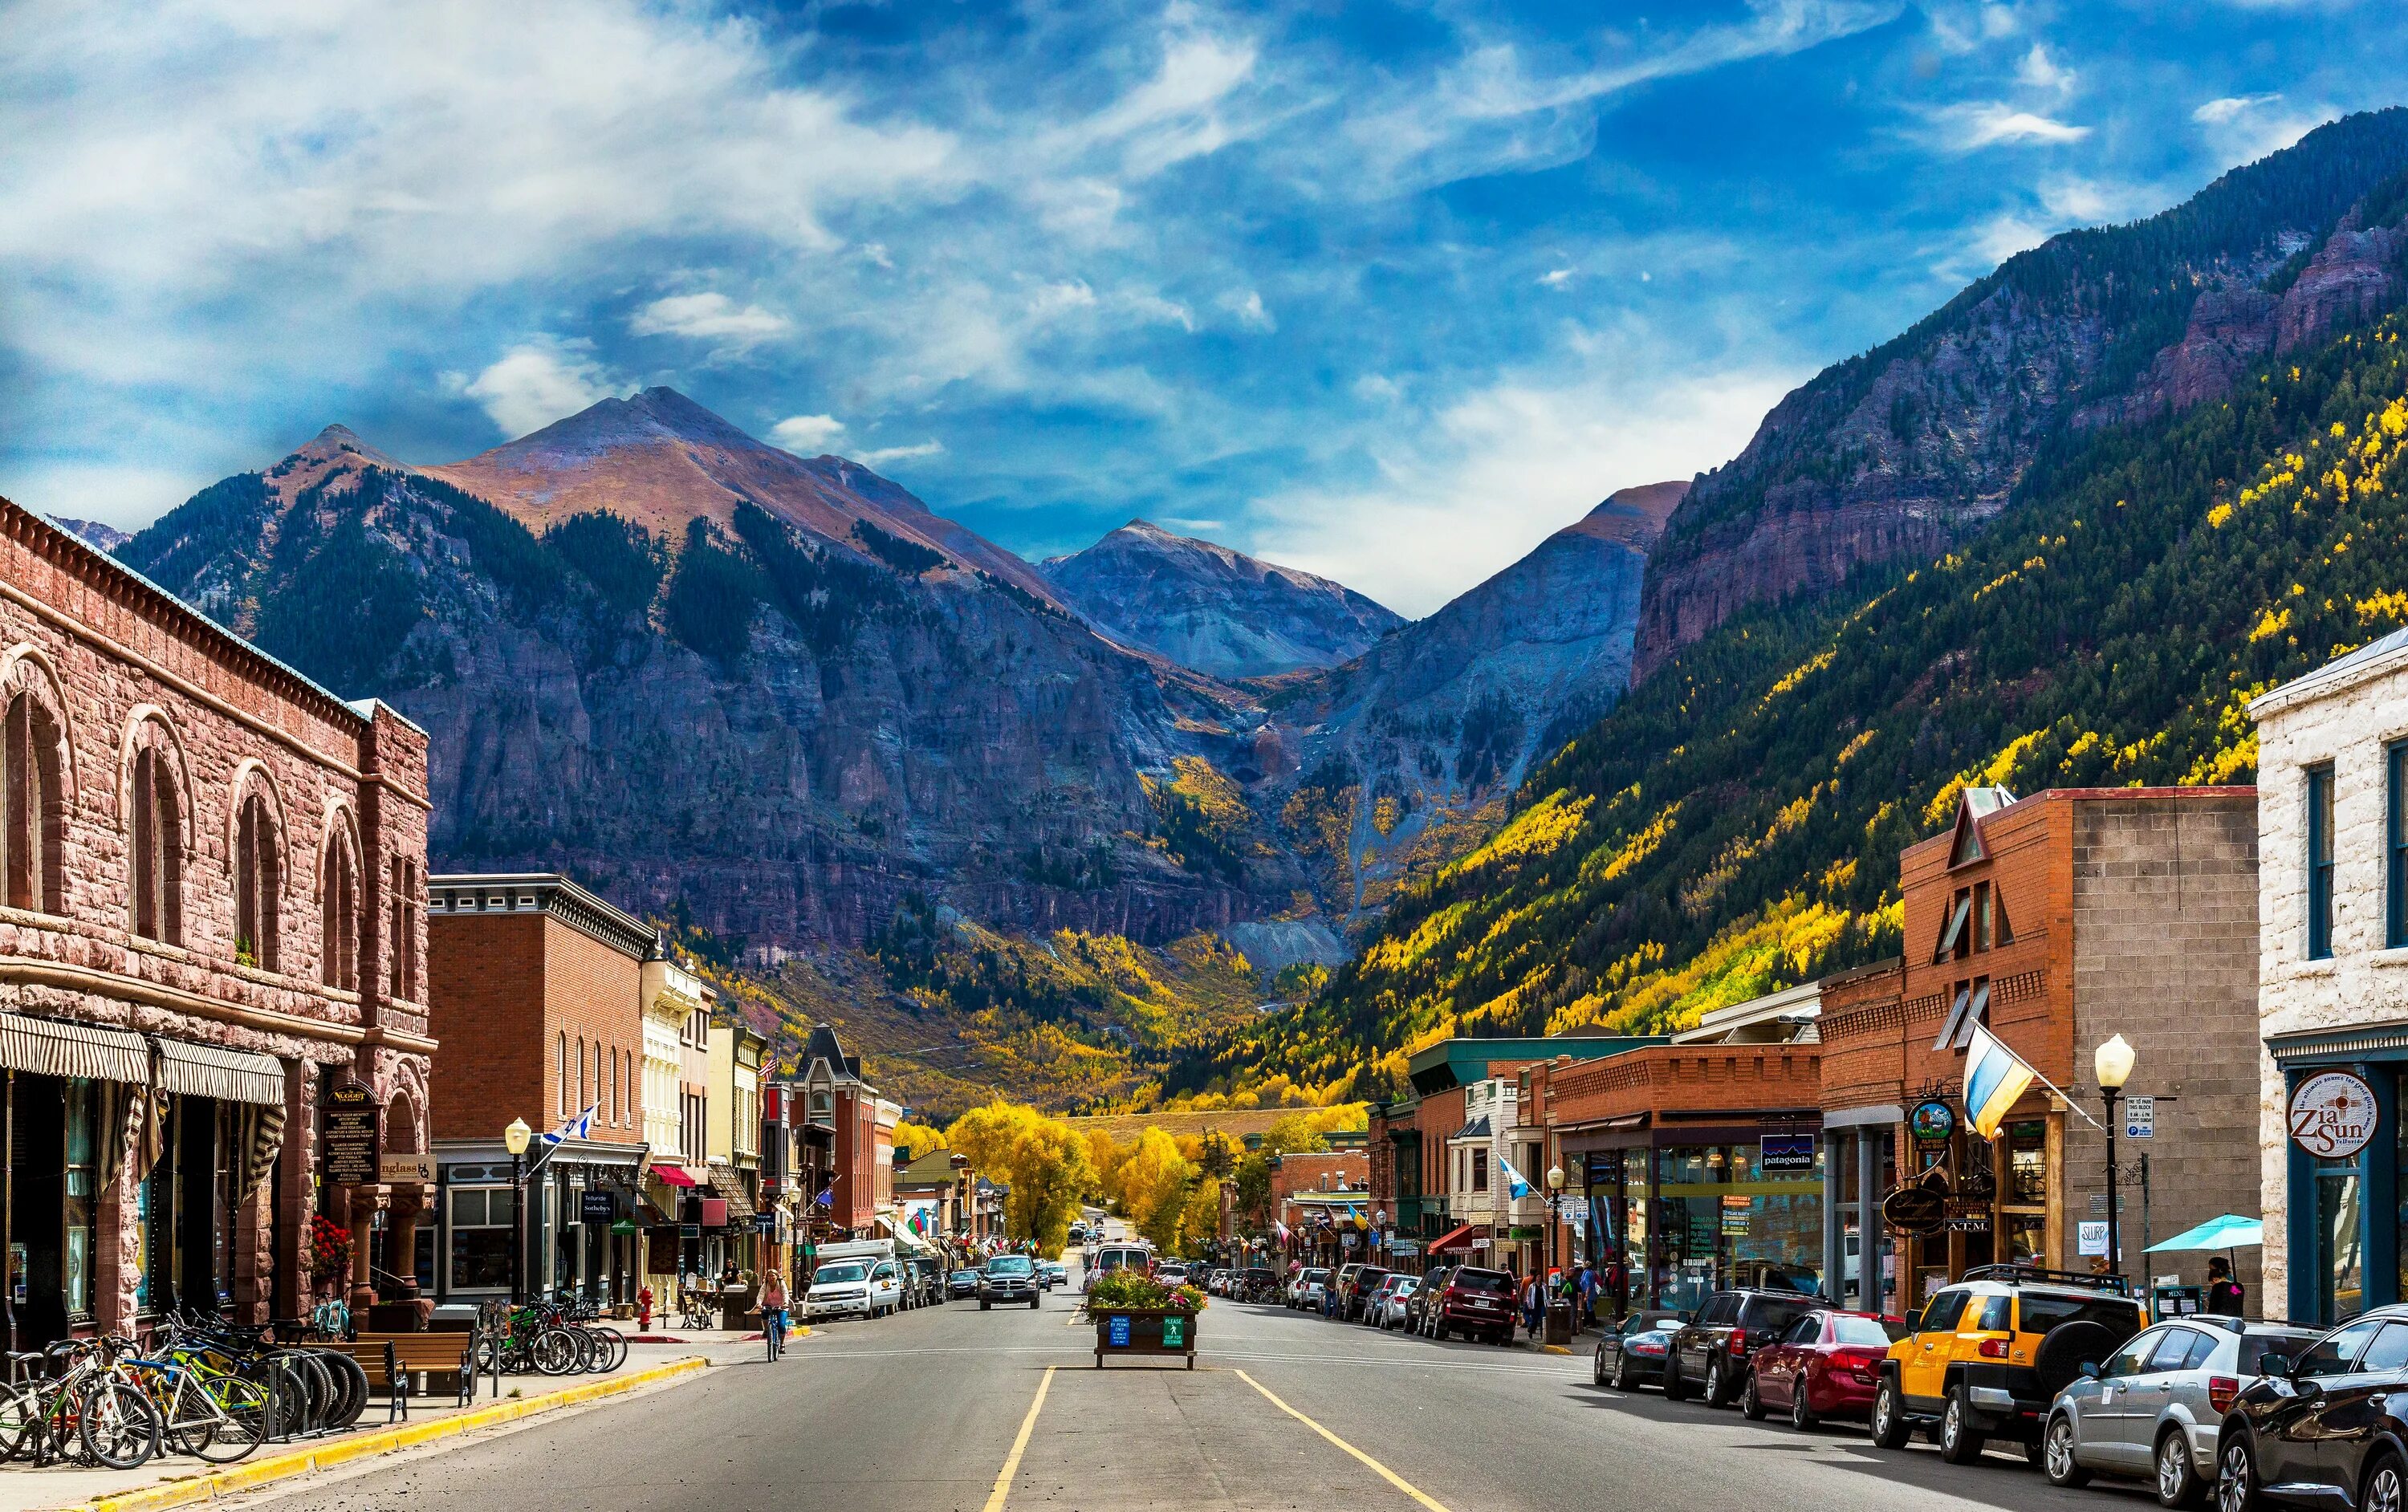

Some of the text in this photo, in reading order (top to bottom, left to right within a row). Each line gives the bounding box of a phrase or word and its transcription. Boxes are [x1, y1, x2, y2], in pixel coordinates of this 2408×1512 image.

[2345, 1076, 2355, 1084] for
[334, 1091, 366, 1103] NUGGET
[2292, 1104, 2339, 1138] Zia
[2316, 1124, 2364, 1152] Sun
[1764, 1156, 1811, 1166] patagonia
[1948, 1222, 1987, 1230] A.T.M.
[2081, 1225, 2105, 1241] SLURP
